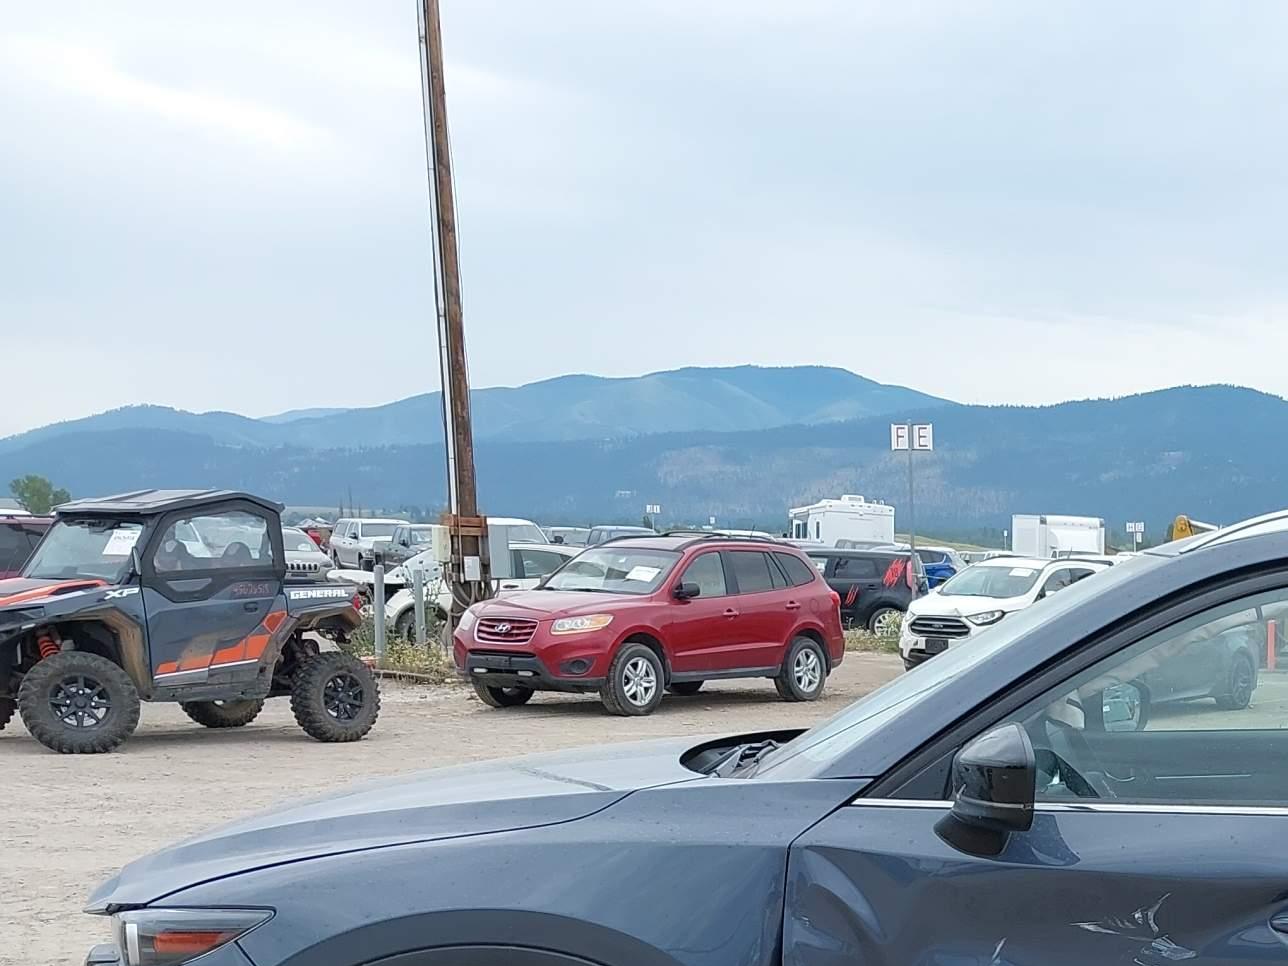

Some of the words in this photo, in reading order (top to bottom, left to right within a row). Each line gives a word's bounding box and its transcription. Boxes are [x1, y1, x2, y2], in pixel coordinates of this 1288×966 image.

[896, 426, 905, 448] F
[918, 426, 928, 448] E
[103, 587, 140, 600] XP
[289, 588, 349, 600] GENERAL
